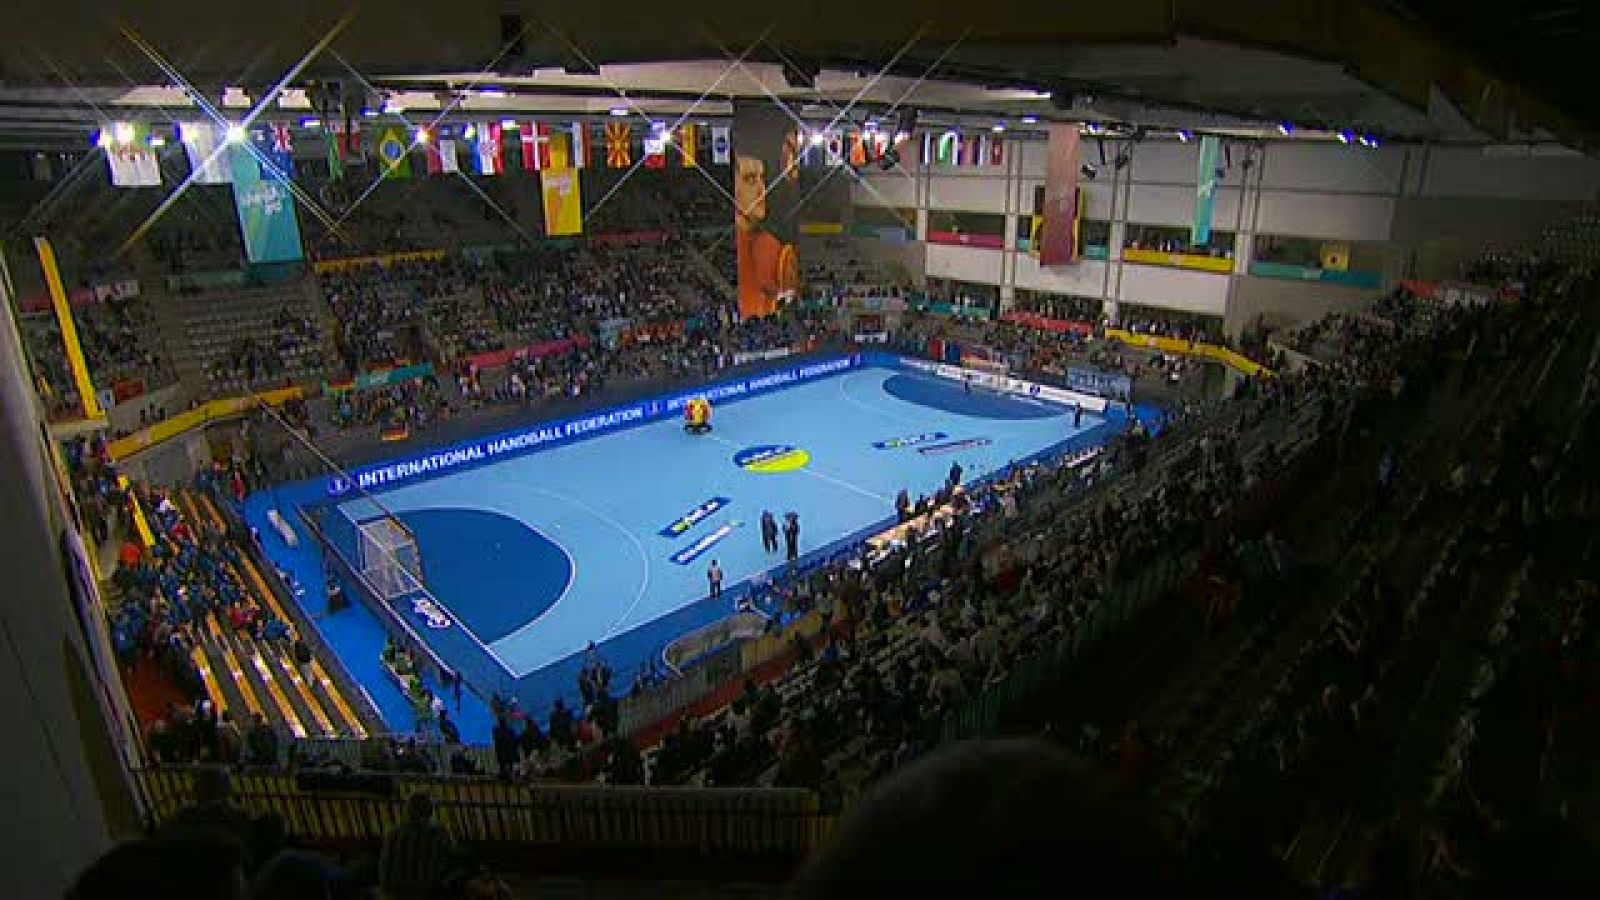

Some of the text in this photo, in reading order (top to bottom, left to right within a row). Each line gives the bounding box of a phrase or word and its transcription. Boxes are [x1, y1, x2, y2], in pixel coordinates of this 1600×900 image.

[750, 369, 796, 388] HANDBALL
[800, 359, 850, 377] FEDERATION
[359, 408, 642, 486] INTERNATIONAL HANDBALL FEDERATION
